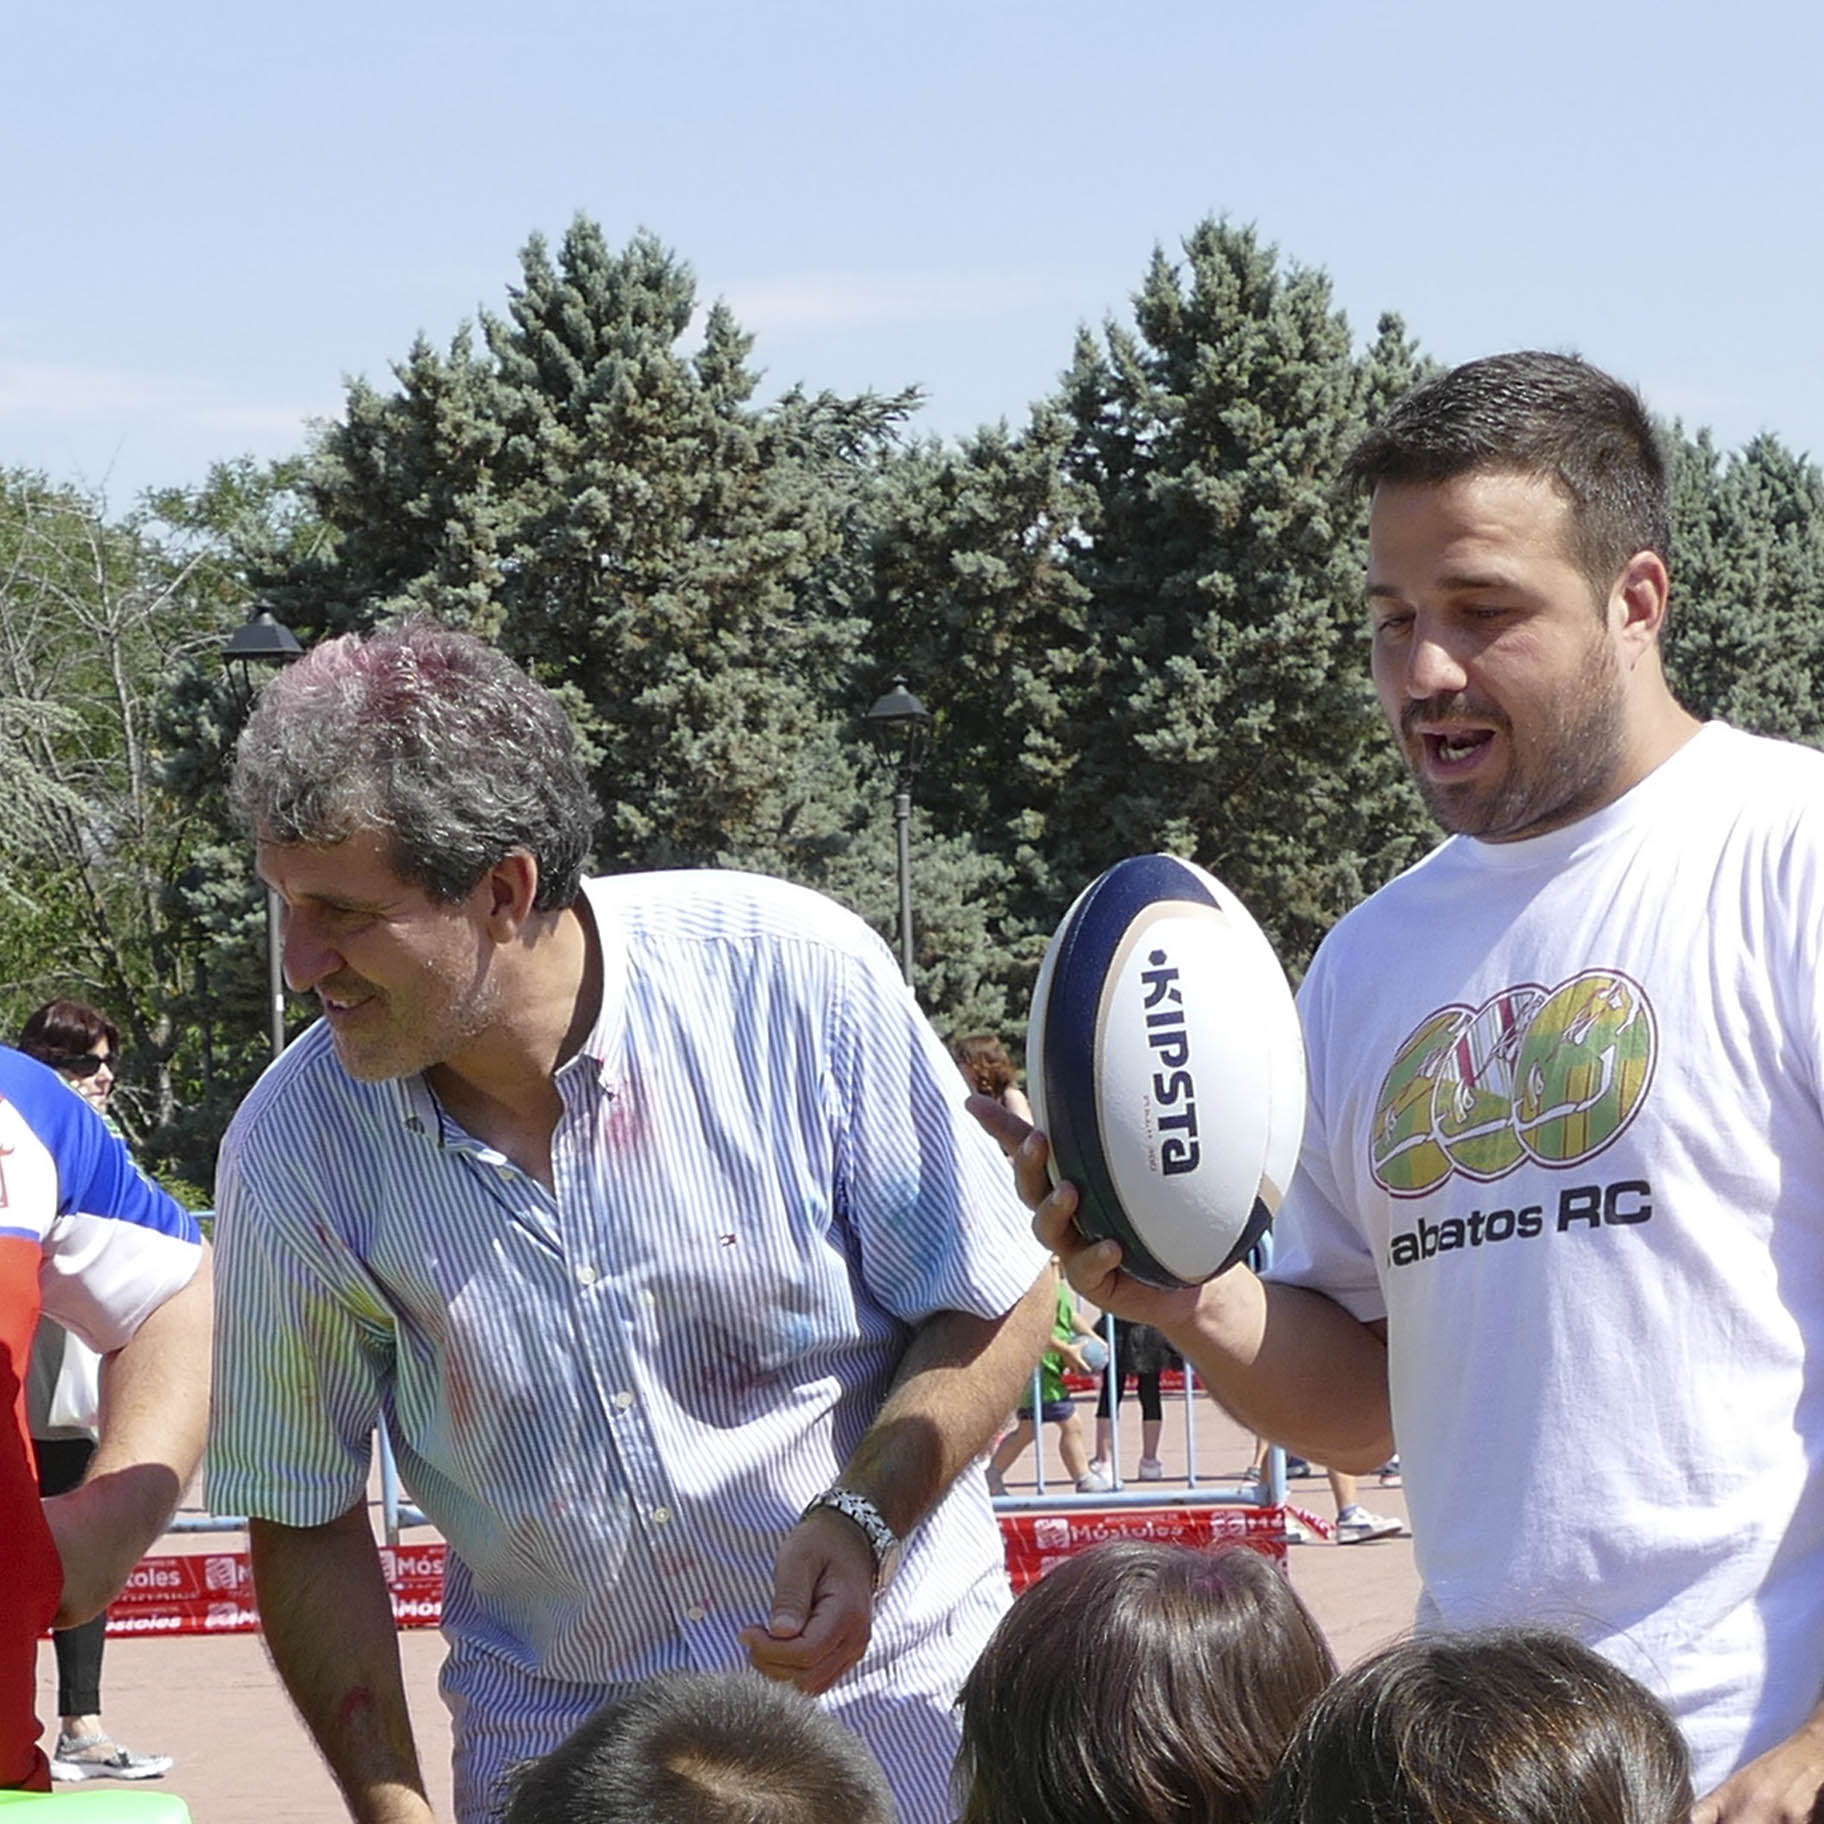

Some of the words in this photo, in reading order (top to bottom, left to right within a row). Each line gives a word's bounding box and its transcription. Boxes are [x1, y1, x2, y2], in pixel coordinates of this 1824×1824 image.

[1387, 1204, 1543, 1268] abatos
[1556, 1179, 1653, 1233] RC
[126, 1568, 181, 1588] toles
